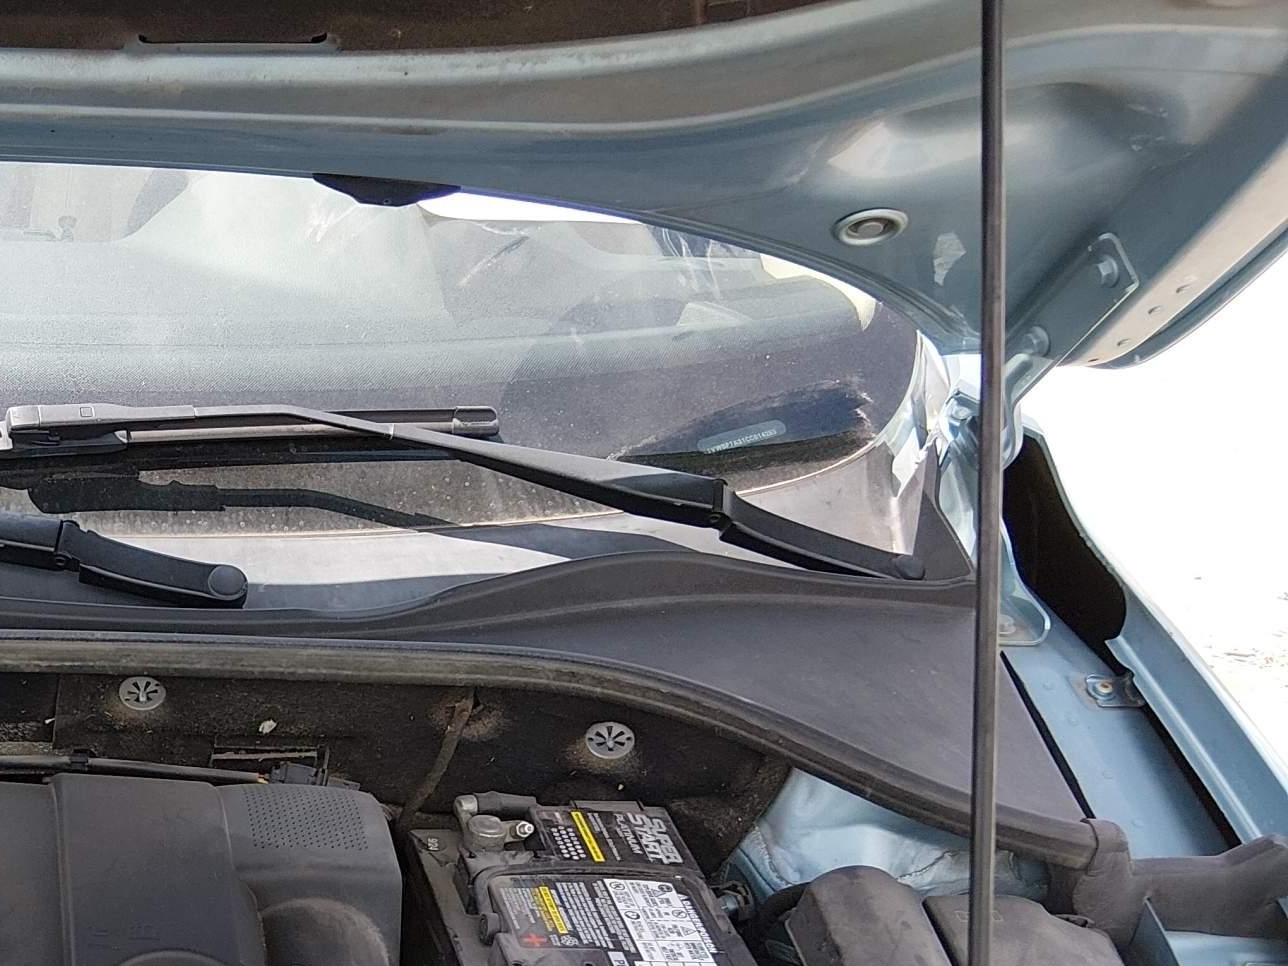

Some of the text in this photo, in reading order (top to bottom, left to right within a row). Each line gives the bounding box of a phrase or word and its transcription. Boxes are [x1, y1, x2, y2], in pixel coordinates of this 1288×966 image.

[614, 813, 644, 855] PLATINUM
[626, 812, 670, 864] START
[651, 818, 683, 864] SUPER
